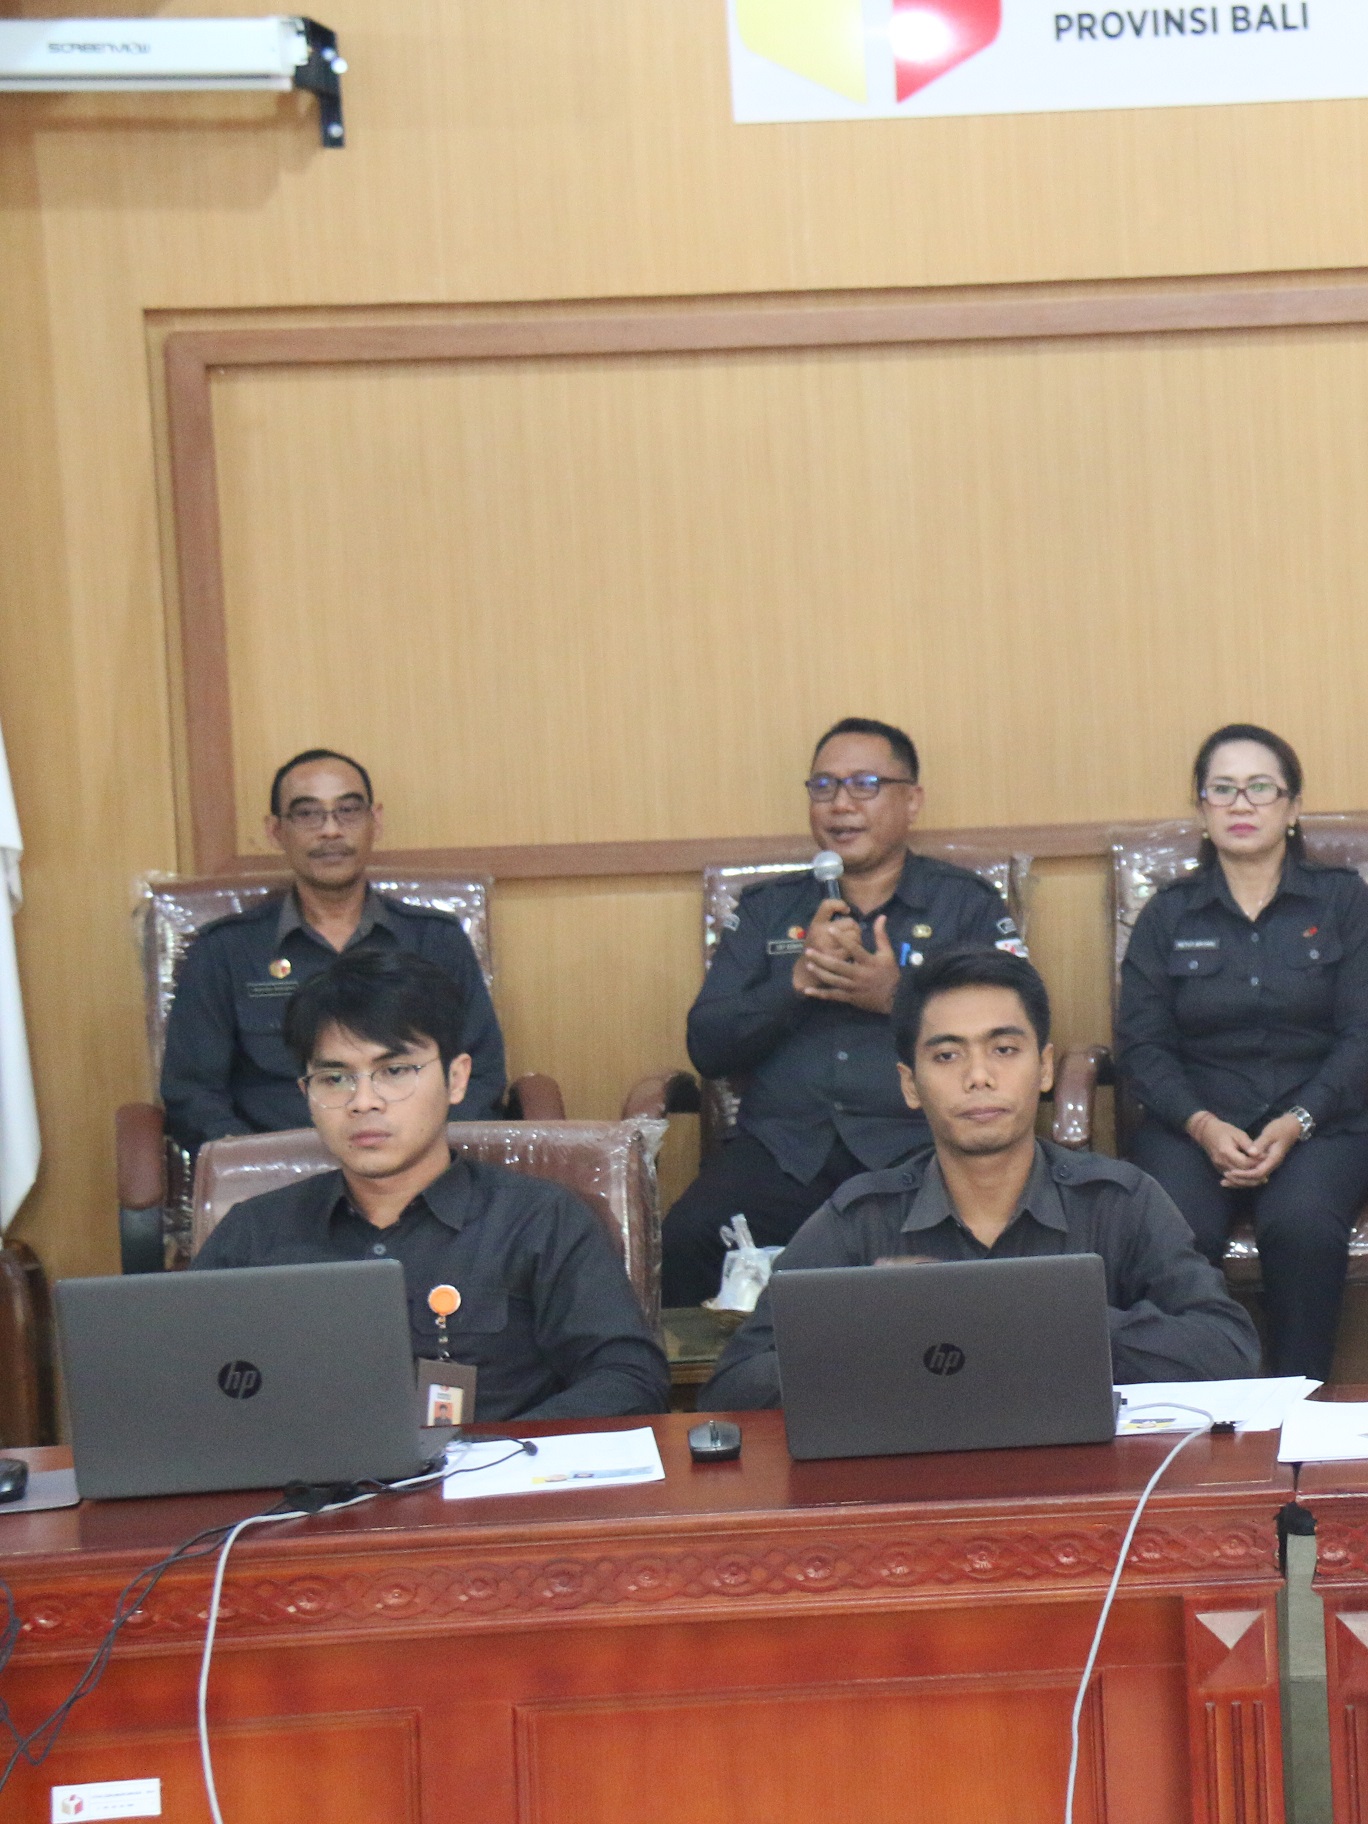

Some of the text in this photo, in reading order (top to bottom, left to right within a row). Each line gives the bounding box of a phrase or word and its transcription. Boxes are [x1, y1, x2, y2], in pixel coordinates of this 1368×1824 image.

[1054, 2, 1309, 42] PROVINSI BALI
[924, 1343, 963, 1376] hp
[220, 1360, 260, 1399] hp
